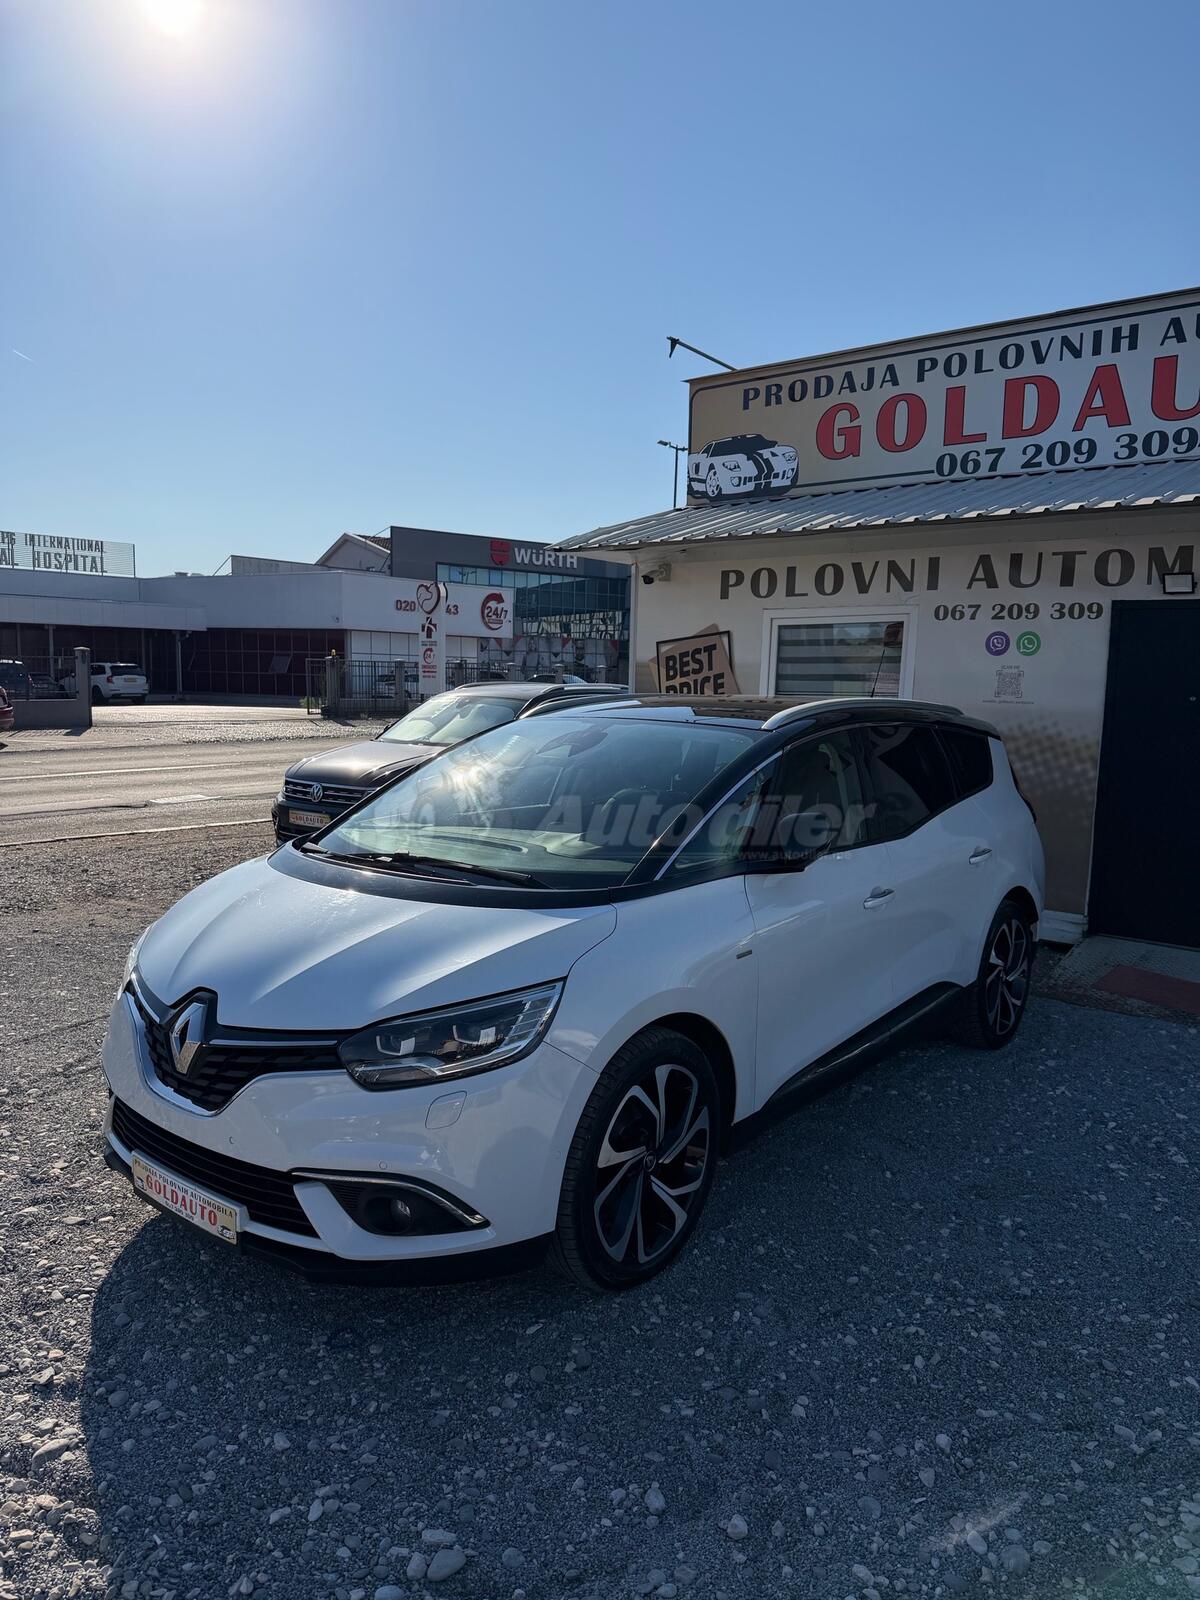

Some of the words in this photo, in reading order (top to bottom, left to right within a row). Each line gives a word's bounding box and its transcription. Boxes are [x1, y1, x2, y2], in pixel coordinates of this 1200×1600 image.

[741, 363, 900, 411] PRODAJA
[916, 323, 1140, 384] POLOVNIH
[1160, 313, 1200, 347] A
[815, 354, 1200, 461] GOLDAU
[935, 447, 1007, 478] 067
[1021, 437, 1098, 470] 209
[1113, 426, 1199, 460] 309
[25, 533, 106, 553] INTERNATIONAL
[33, 551, 107, 573] HOSPITAL
[514, 547, 578, 569] WÜRTH
[719, 555, 942, 600] POLOVNI
[966, 544, 1194, 591] AUTOM
[395, 599, 416, 612] 020
[486, 605, 508, 619] 24/7
[933, 604, 982, 622] 067
[991, 603, 1040, 621] 209
[1049, 601, 1104, 620] 309
[665, 643, 717, 682] BEST
[146, 1174, 218, 1227] GOLDAUTO
[190, 1191, 233, 1218] AUTOMOBILA
